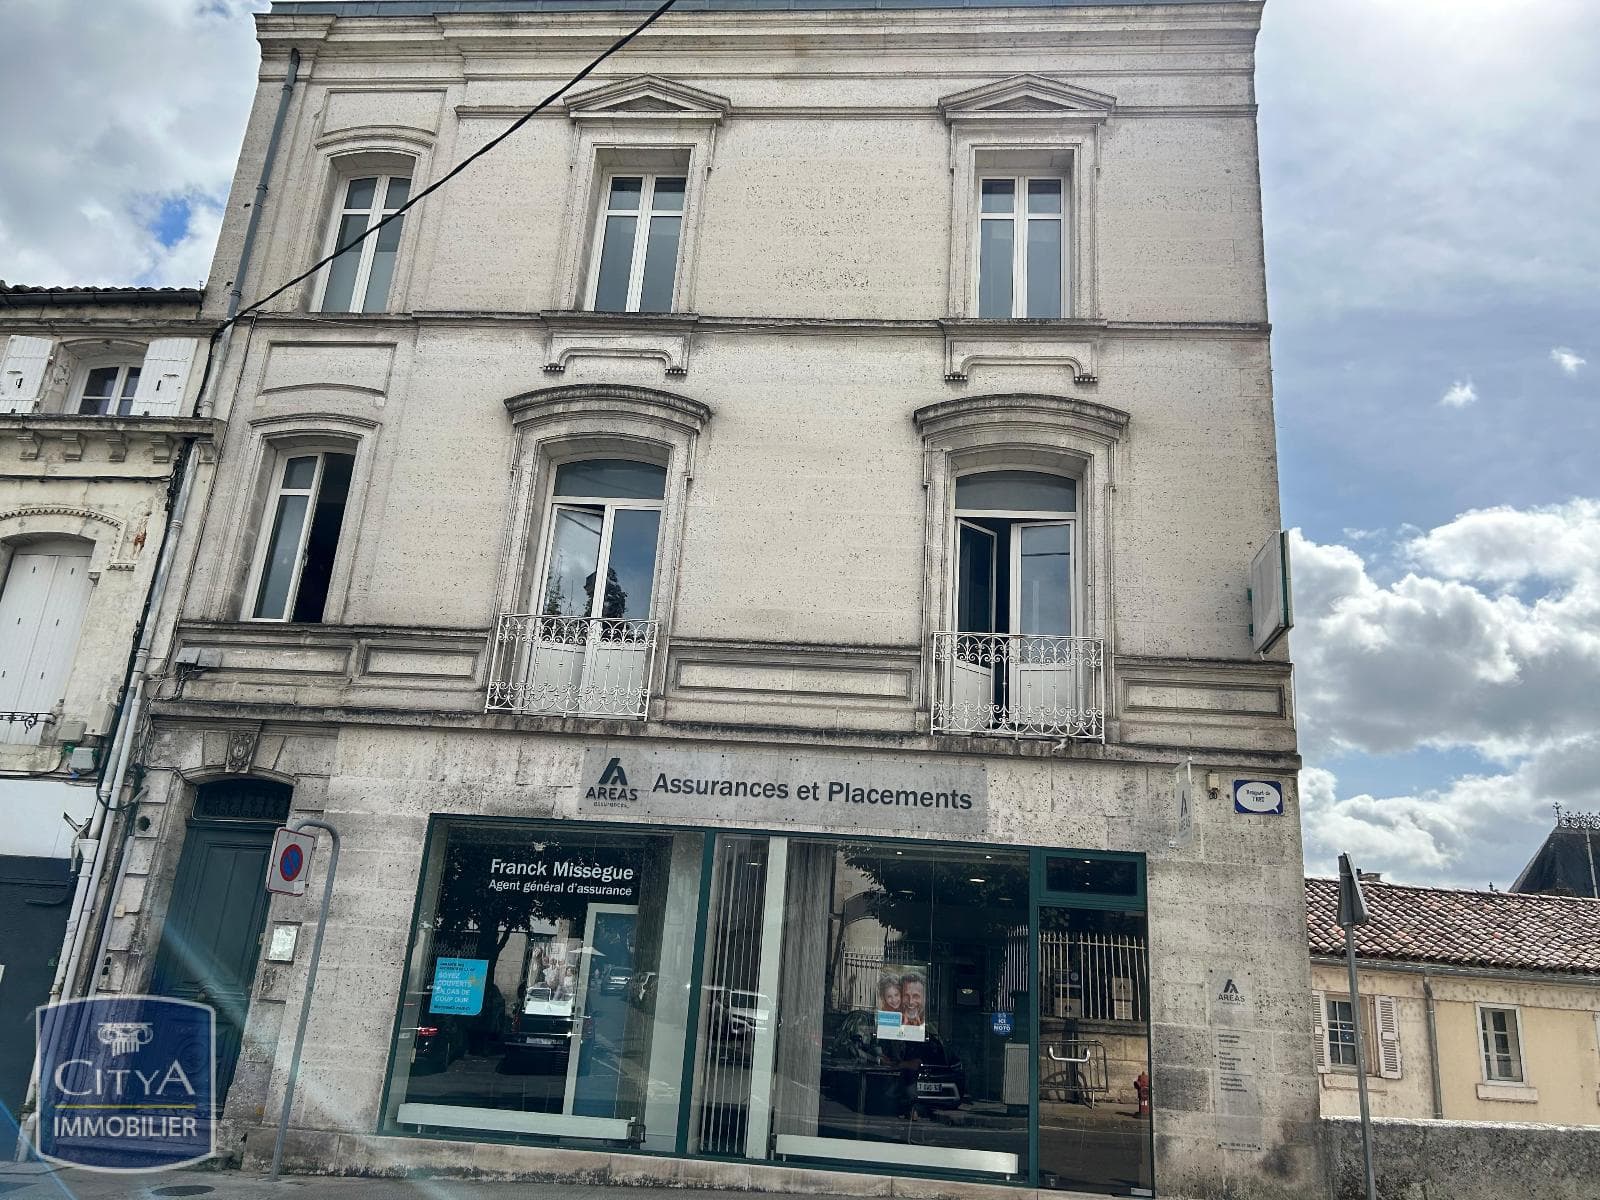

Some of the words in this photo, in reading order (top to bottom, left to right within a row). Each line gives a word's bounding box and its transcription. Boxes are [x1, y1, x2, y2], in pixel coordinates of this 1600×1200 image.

[585, 786, 638, 801] AREAS
[652, 773, 789, 799] Assurances
[796, 781, 820, 802] et
[828, 781, 973, 810] Placements
[490, 858, 547, 876] Franck
[553, 860, 634, 882] Missègue
[488, 879, 520, 892] Agent
[523, 881, 564, 893] général
[567, 882, 632, 896] d'assurance
[1218, 992, 1246, 1003] AREAS
